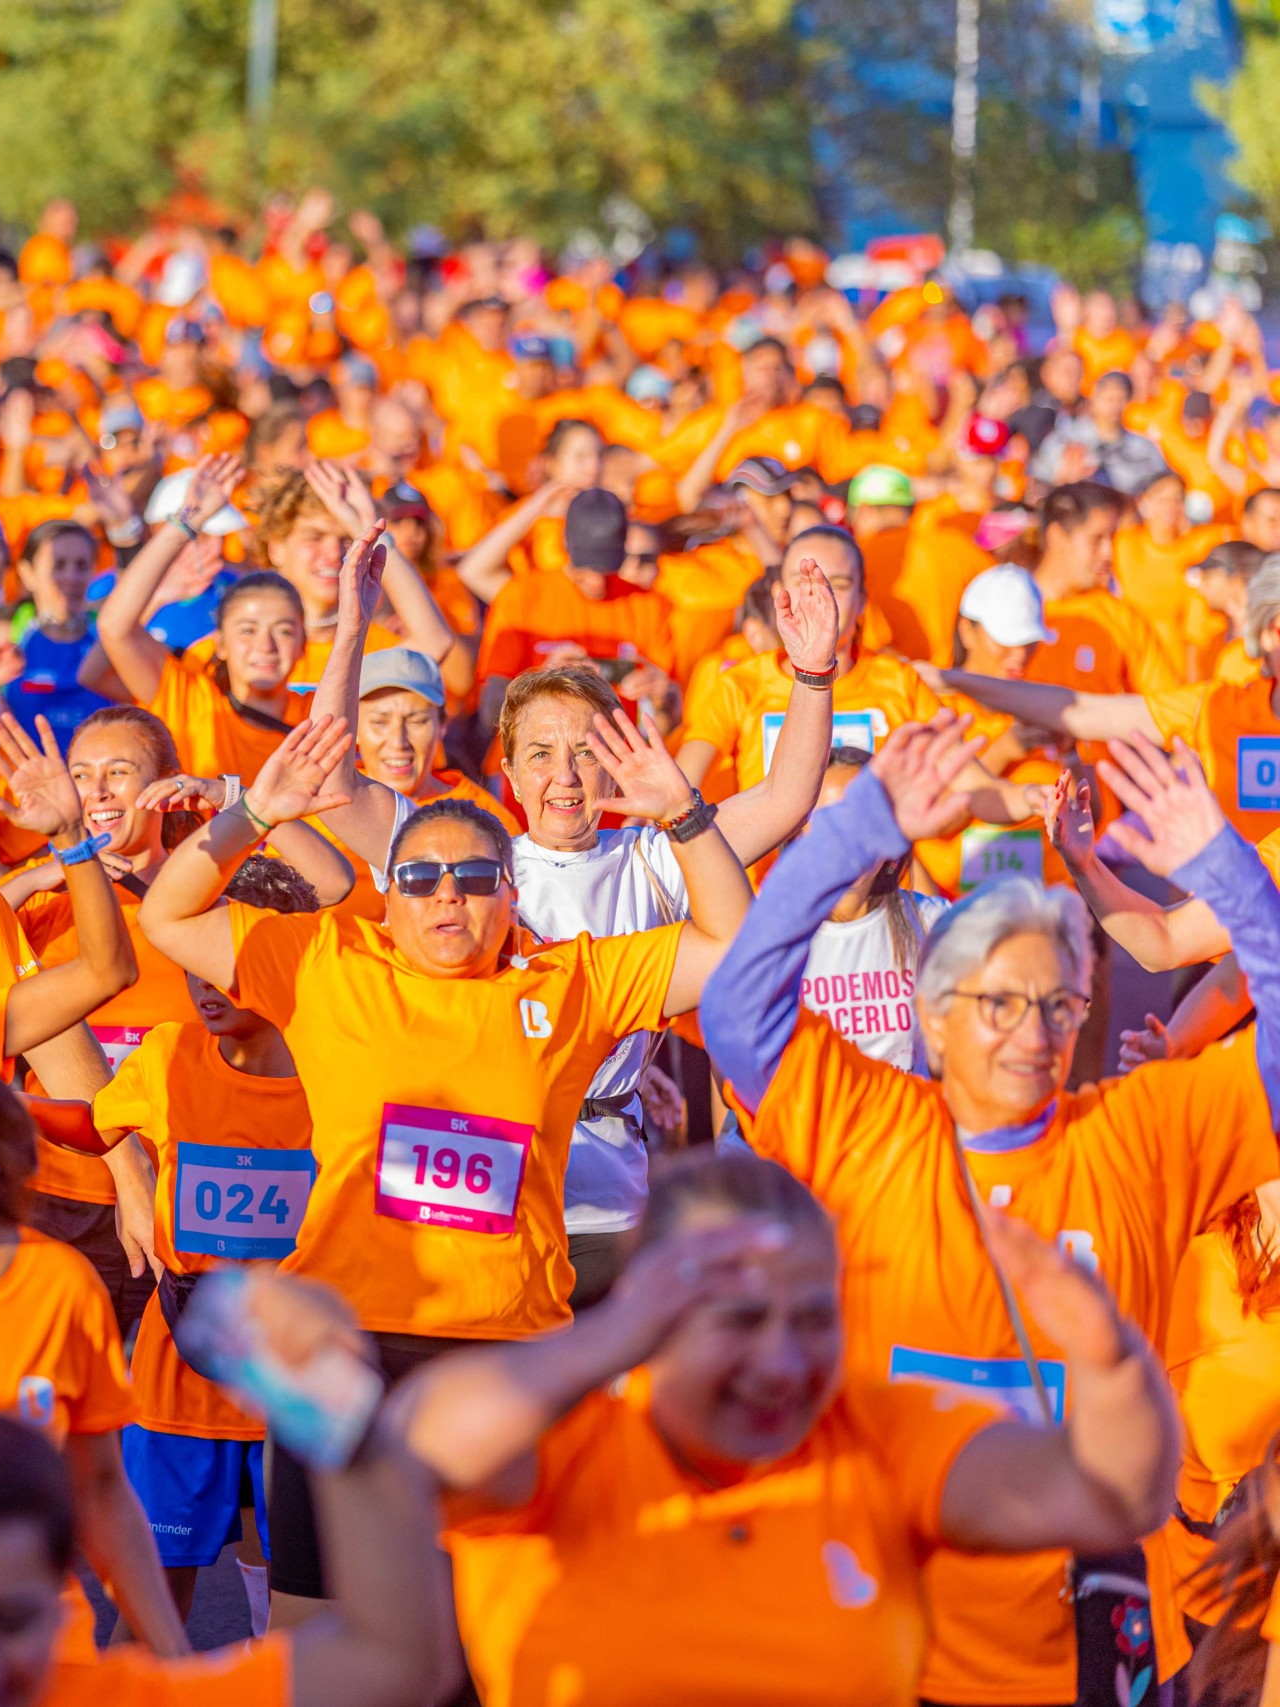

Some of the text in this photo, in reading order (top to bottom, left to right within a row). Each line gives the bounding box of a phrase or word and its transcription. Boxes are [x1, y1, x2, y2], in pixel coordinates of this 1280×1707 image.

[802, 969, 915, 1004] PODEMOS
[821, 1003, 911, 1036] CERLO
[125, 1032, 141, 1043] 5K
[450, 1118, 469, 1132] 5K
[236, 1155, 253, 1167] 3K
[412, 1144, 493, 1195] 196
[195, 1180, 290, 1225] 024
